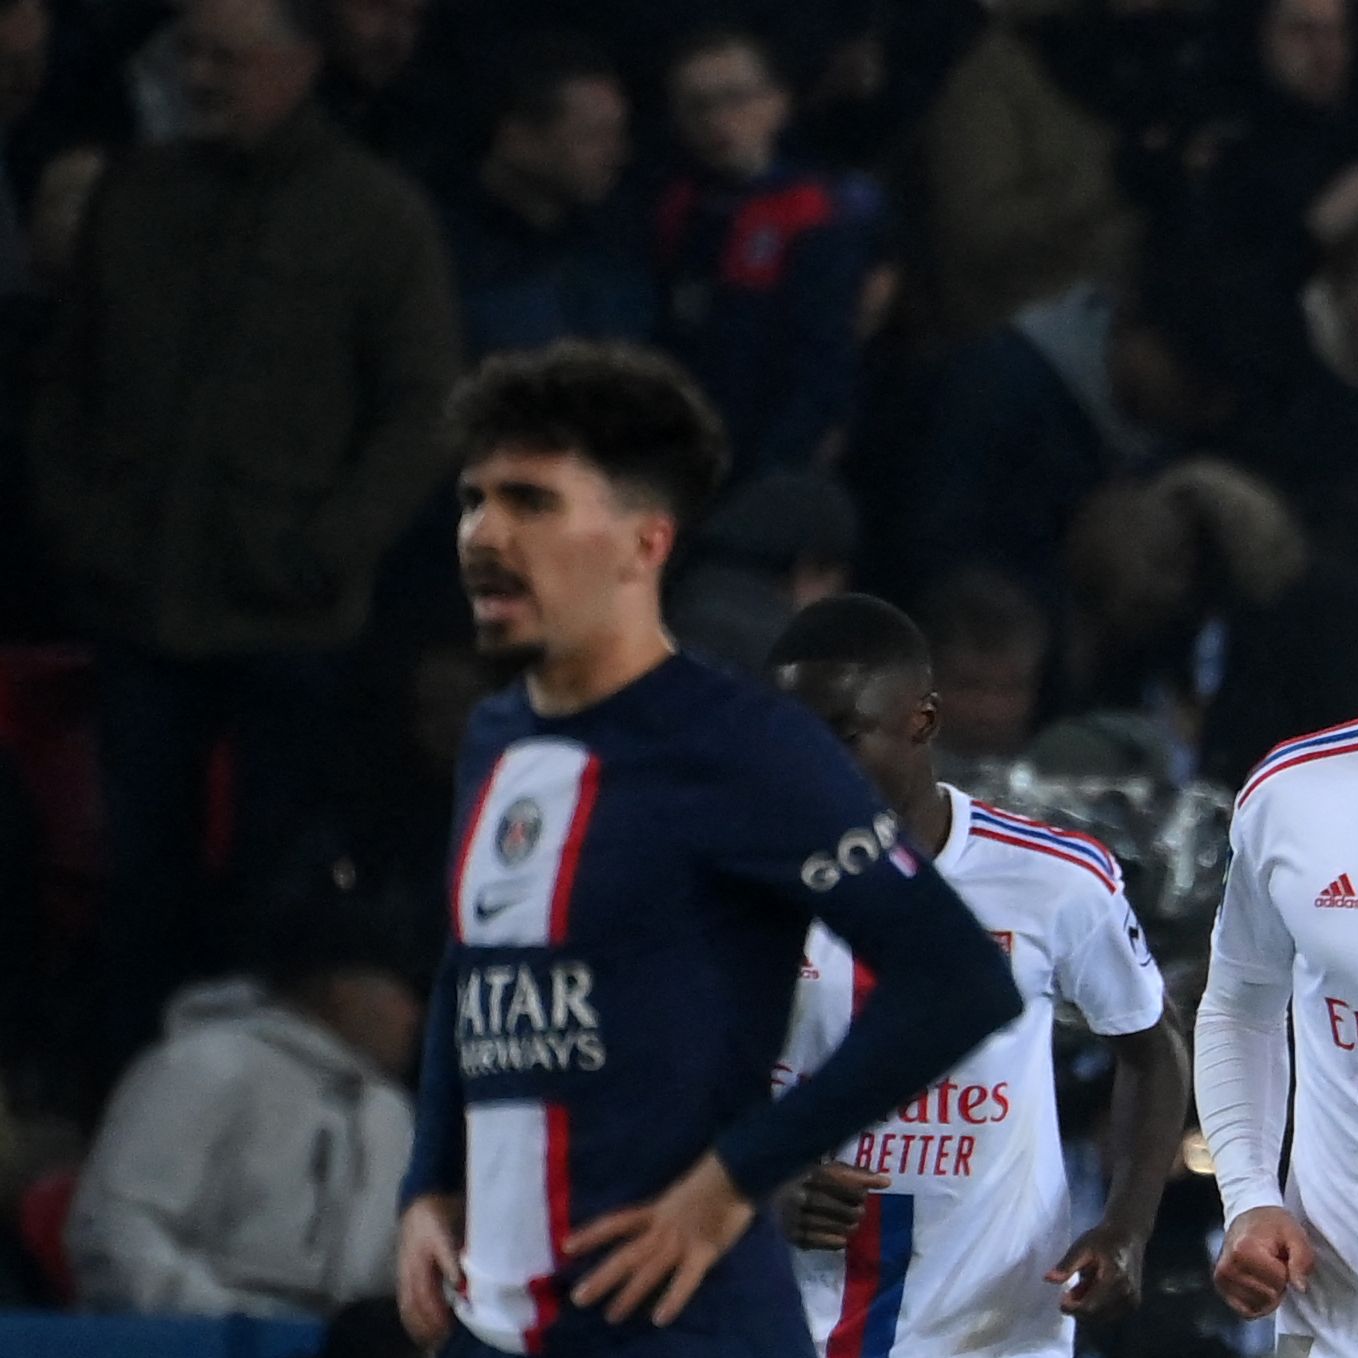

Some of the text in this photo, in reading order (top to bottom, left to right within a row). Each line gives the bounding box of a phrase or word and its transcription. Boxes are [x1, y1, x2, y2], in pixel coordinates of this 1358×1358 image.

[455, 961, 600, 1036] ATAR
[897, 1077, 1009, 1124] ates
[855, 1131, 975, 1176] BETTER
